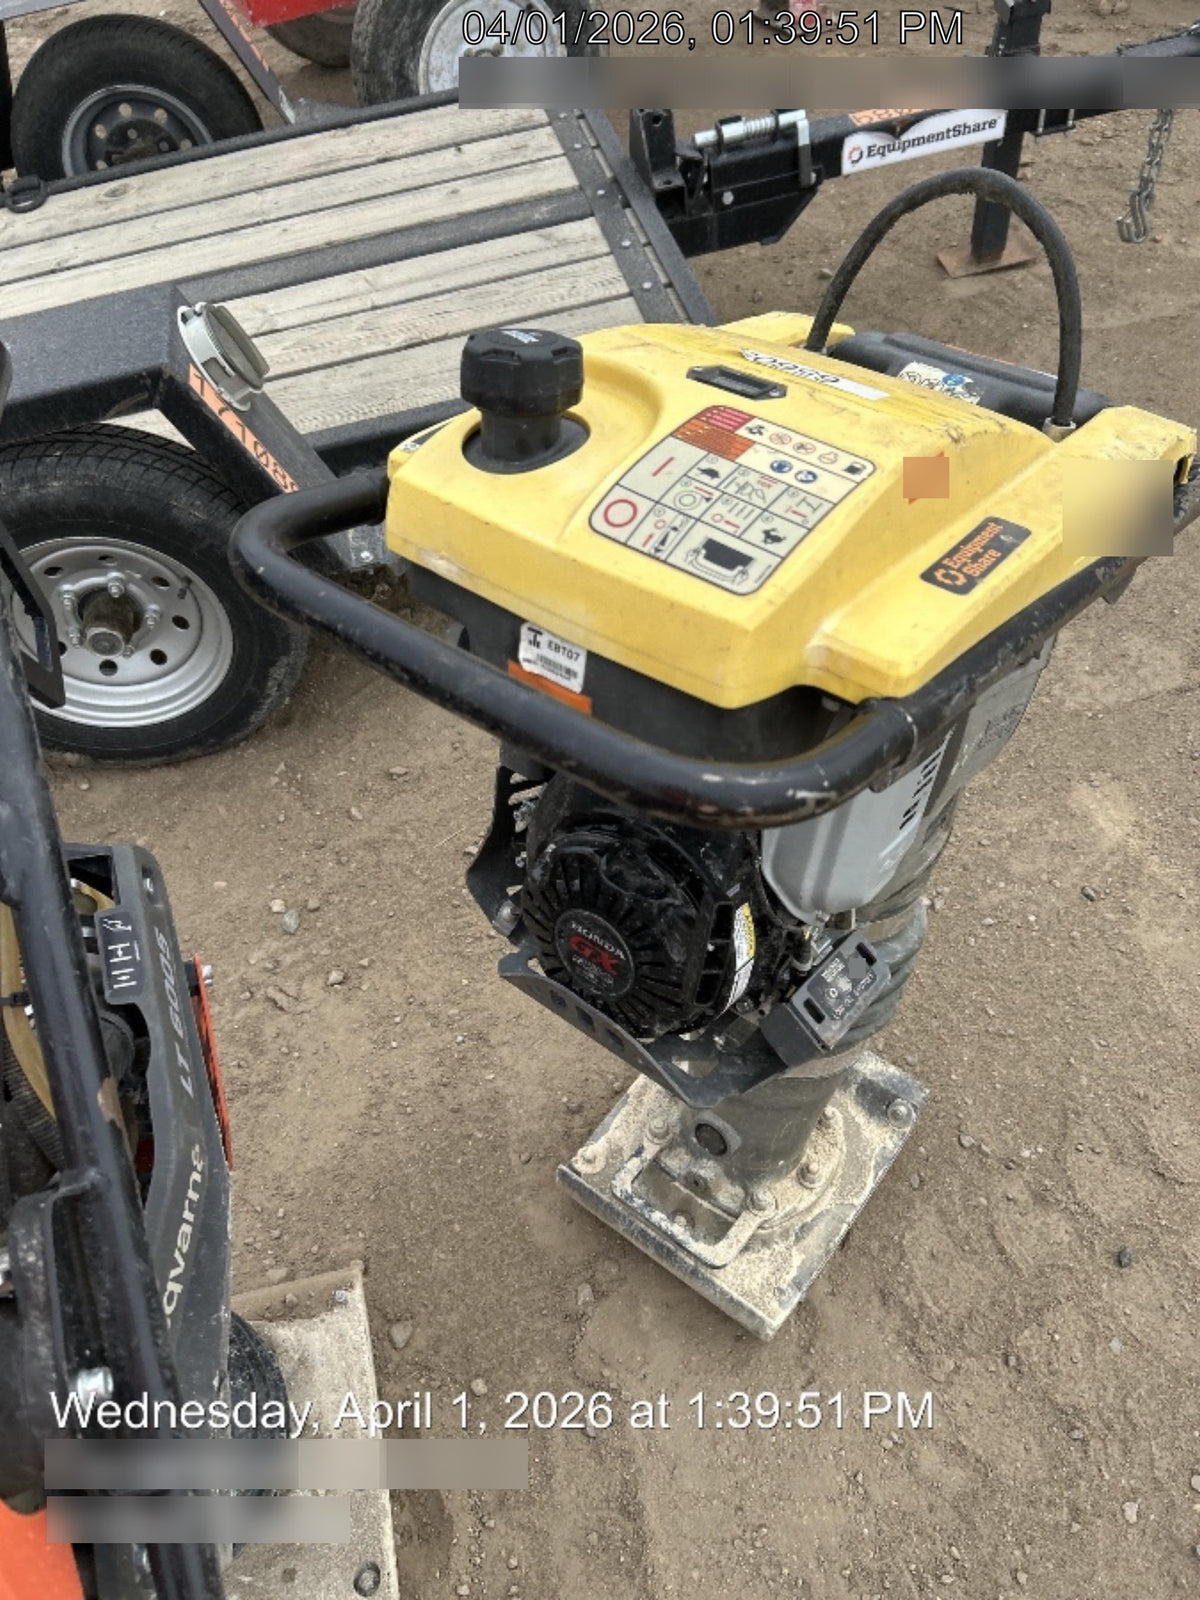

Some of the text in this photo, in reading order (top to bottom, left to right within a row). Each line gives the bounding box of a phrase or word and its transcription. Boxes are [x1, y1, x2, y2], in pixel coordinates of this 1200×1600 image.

[866, 118, 997, 159] EquipmentShare
[941, 522, 1003, 569] Equipment
[962, 548, 1002, 577] Share
[174, 1041, 194, 1099] LT
